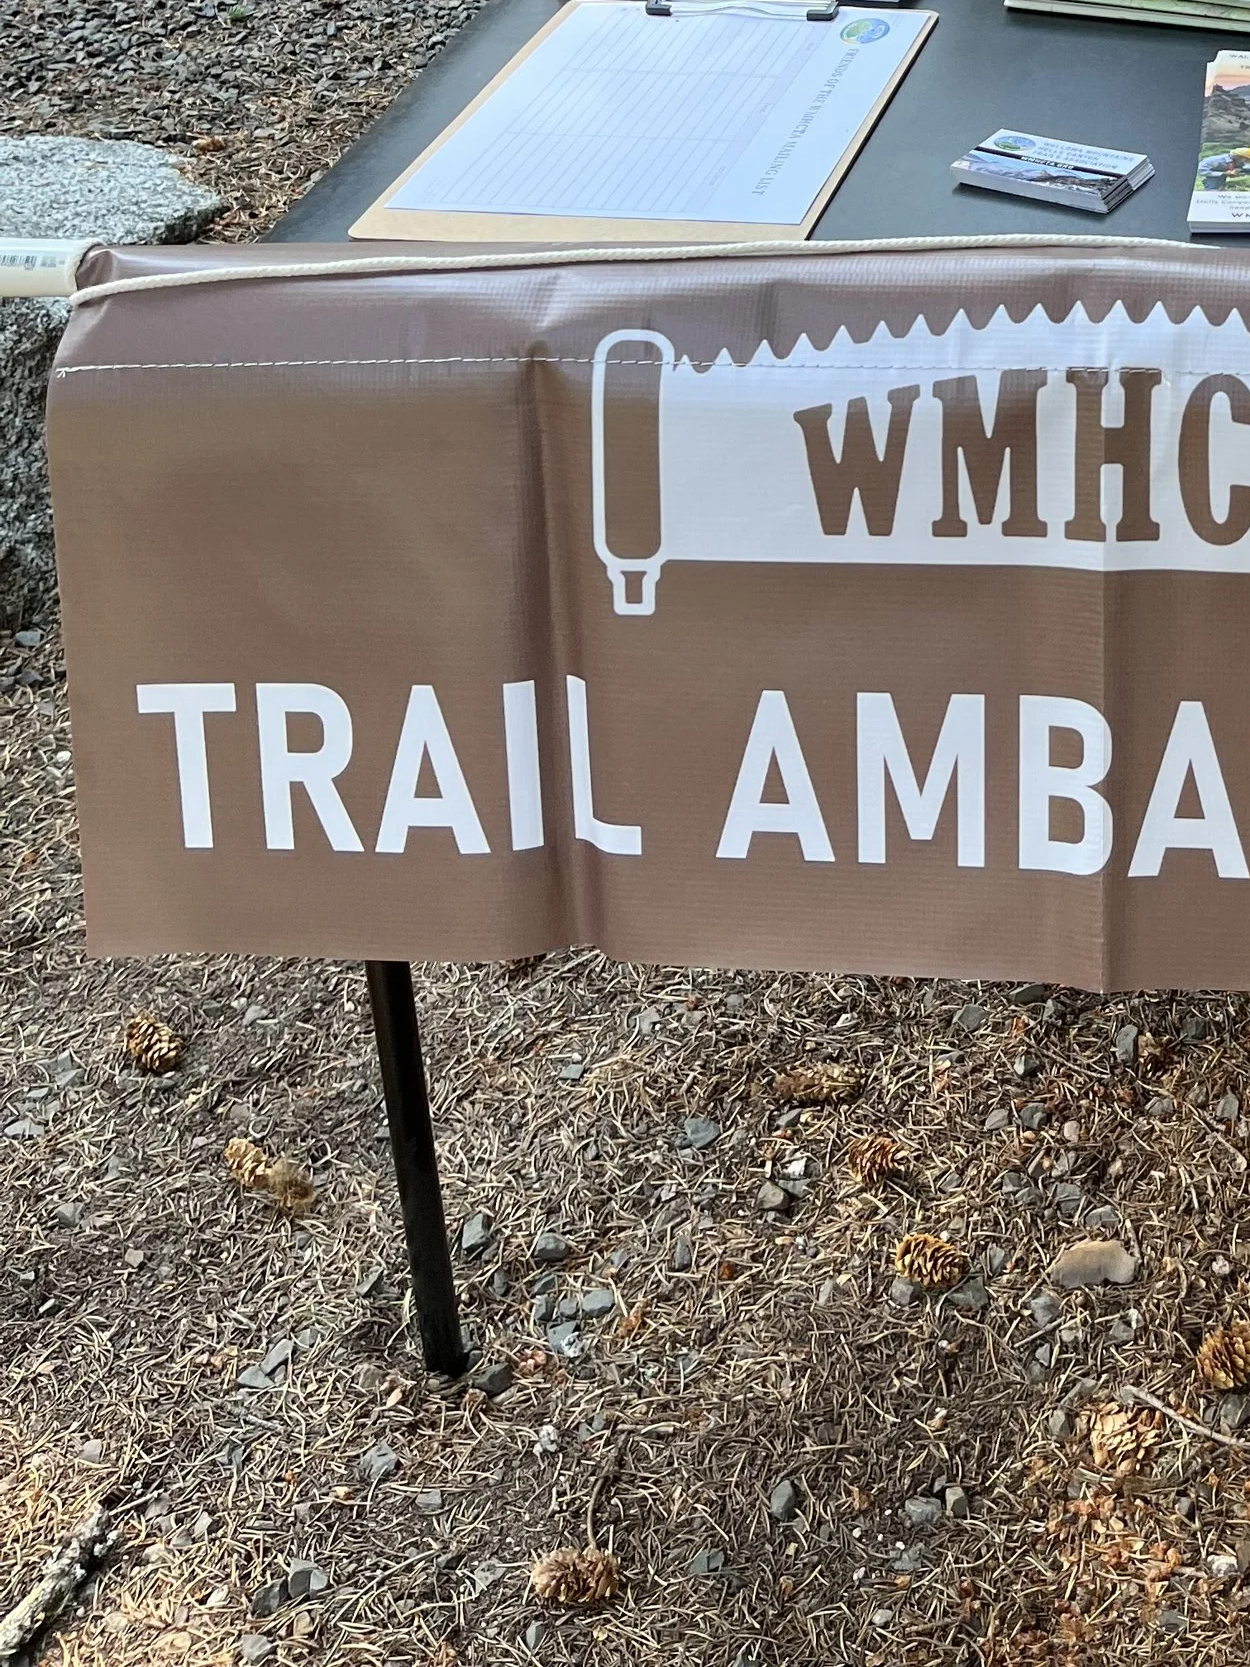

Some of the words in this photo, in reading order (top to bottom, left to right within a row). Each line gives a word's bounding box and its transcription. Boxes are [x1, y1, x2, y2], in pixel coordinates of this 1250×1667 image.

[832, 48, 859, 77] FRIENDS
[824, 77, 839, 89] OF
[812, 89, 832, 105] THE
[765, 139, 797, 180] MAILING
[752, 176, 773, 196] LIST
[137, 676, 641, 855] TRAIL
